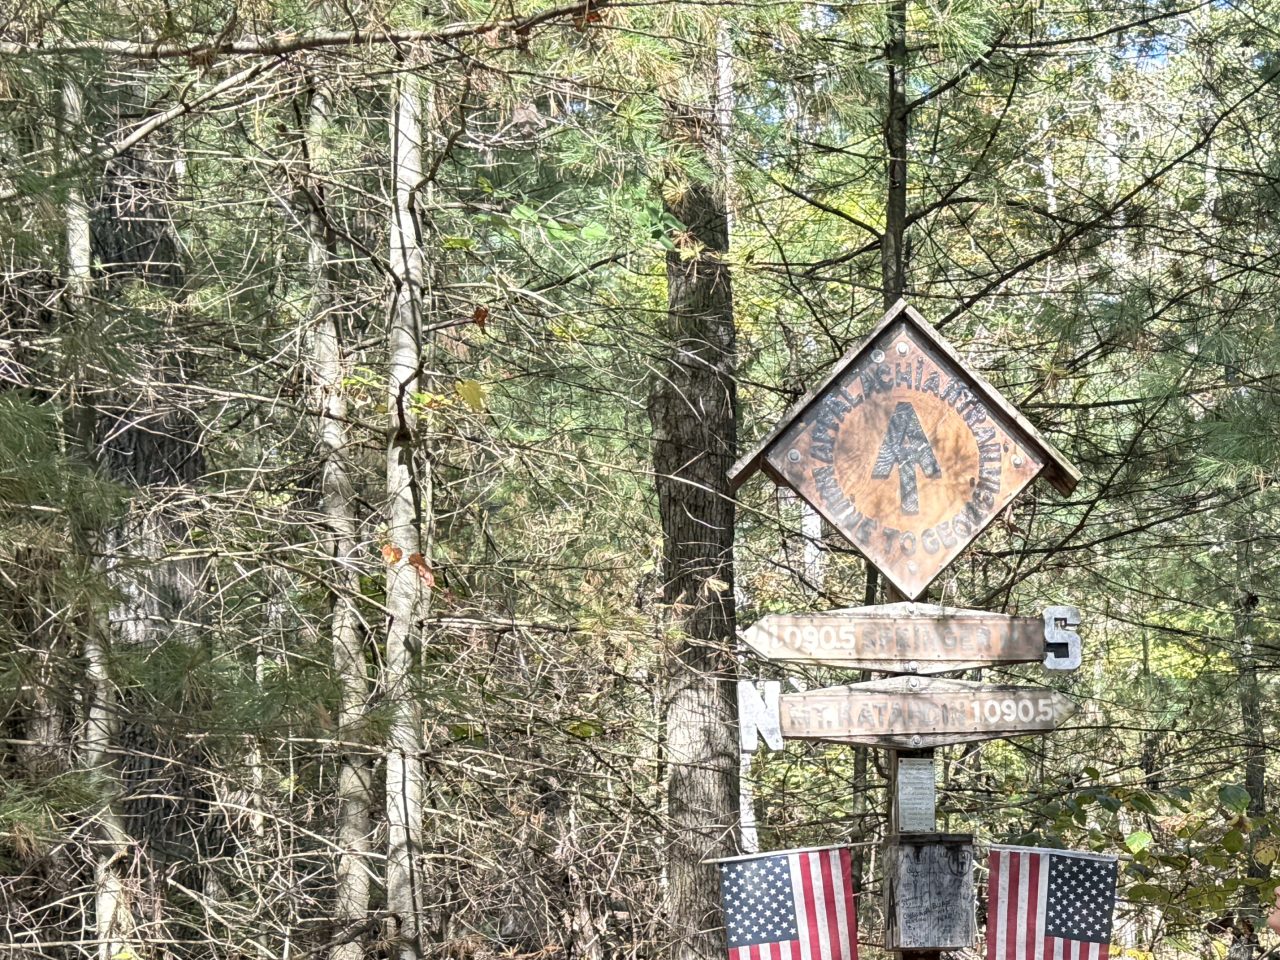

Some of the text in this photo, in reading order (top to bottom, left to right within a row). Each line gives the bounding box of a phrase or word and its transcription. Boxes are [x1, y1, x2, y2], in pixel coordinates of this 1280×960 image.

[810, 359, 1002, 467] APPALACHIAN TRAIL
[812, 465, 1002, 557] MAINE TO GEORGIA
[1043, 605, 1082, 671] S
[737, 680, 784, 751] N
[837, 701, 968, 729] KATAHDIN
[970, 698, 1053, 724] 1090.5
